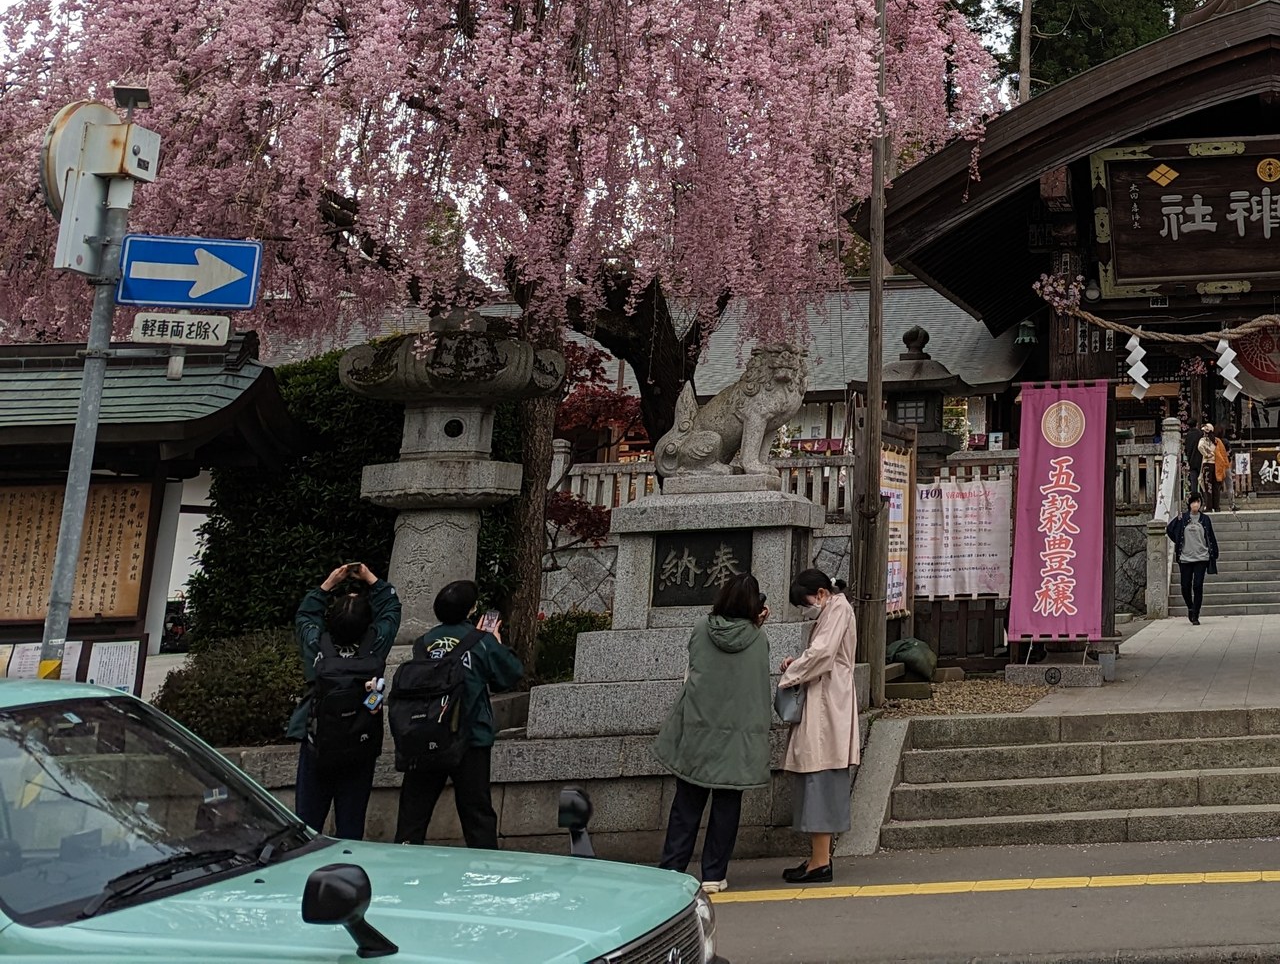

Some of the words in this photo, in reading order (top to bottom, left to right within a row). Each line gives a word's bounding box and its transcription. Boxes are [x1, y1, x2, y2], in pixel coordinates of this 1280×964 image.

[141, 318, 222, 342] 軽車両を除く
[1032, 455, 1082, 616] 五穀豊穣
[659, 541, 747, 591] 奉納
